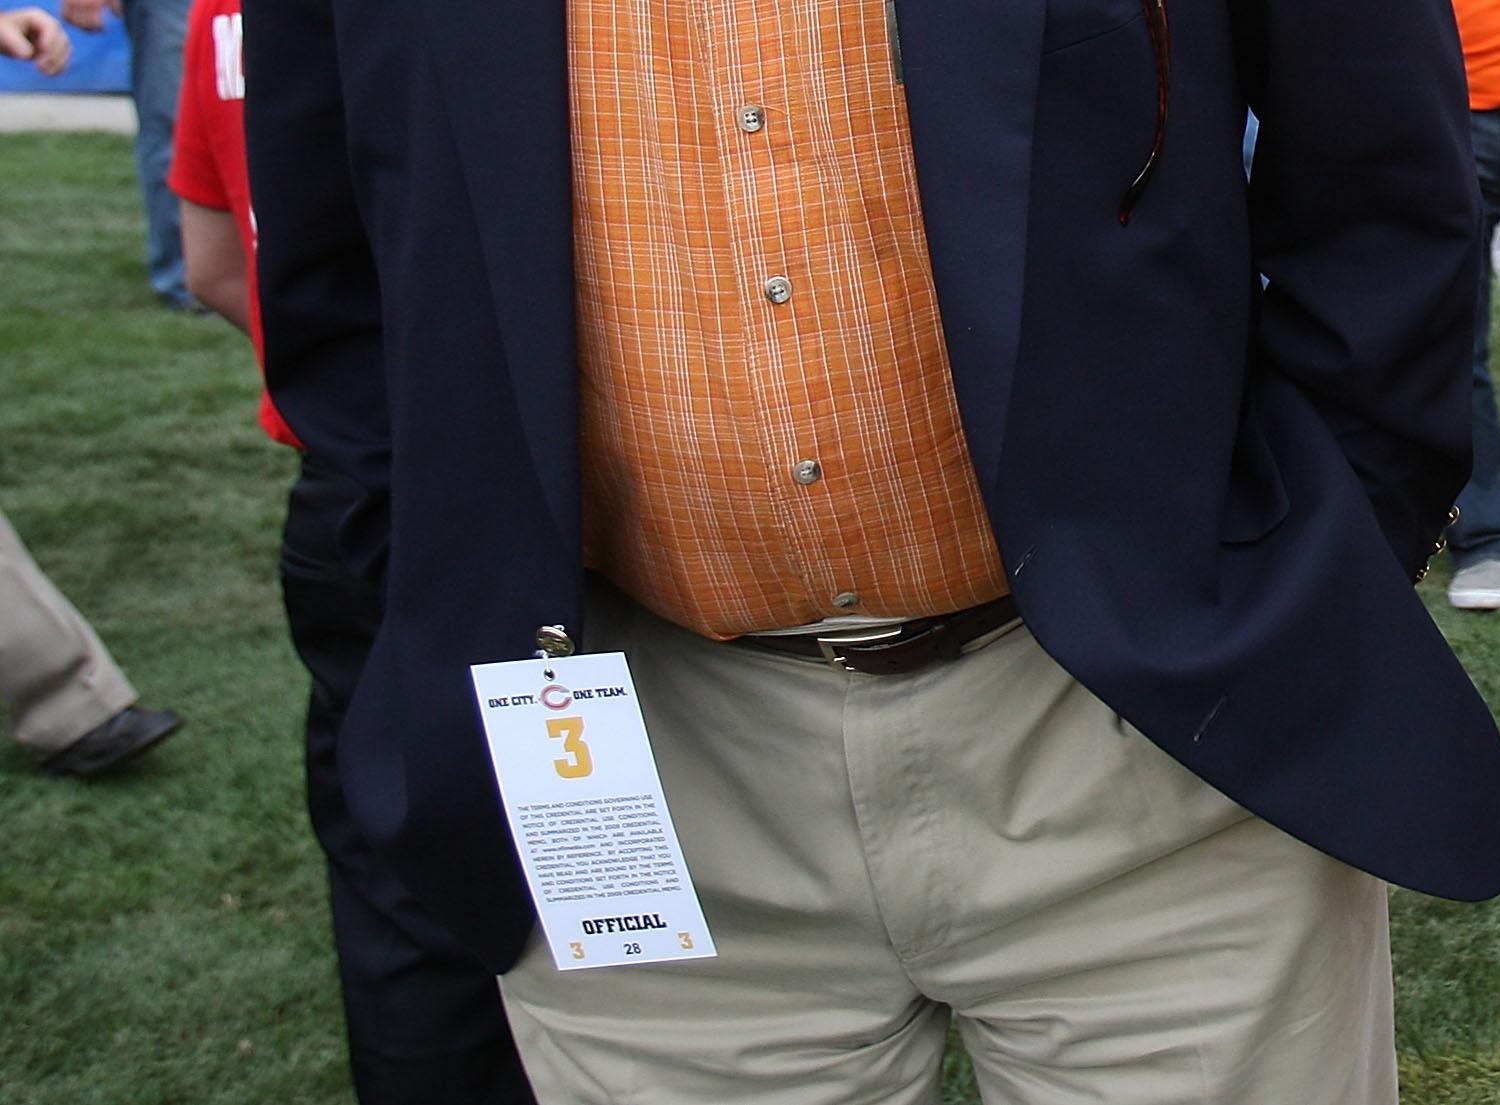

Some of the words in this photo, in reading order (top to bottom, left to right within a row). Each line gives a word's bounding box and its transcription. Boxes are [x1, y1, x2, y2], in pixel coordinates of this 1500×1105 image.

[488, 697, 509, 708] ONE
[573, 689, 593, 700] ONE
[546, 716, 593, 779] 3
[582, 913, 668, 935] OFFICIAL
[568, 942, 585, 959] 3
[624, 942, 642, 955] 28
[677, 932, 694, 949] 3
